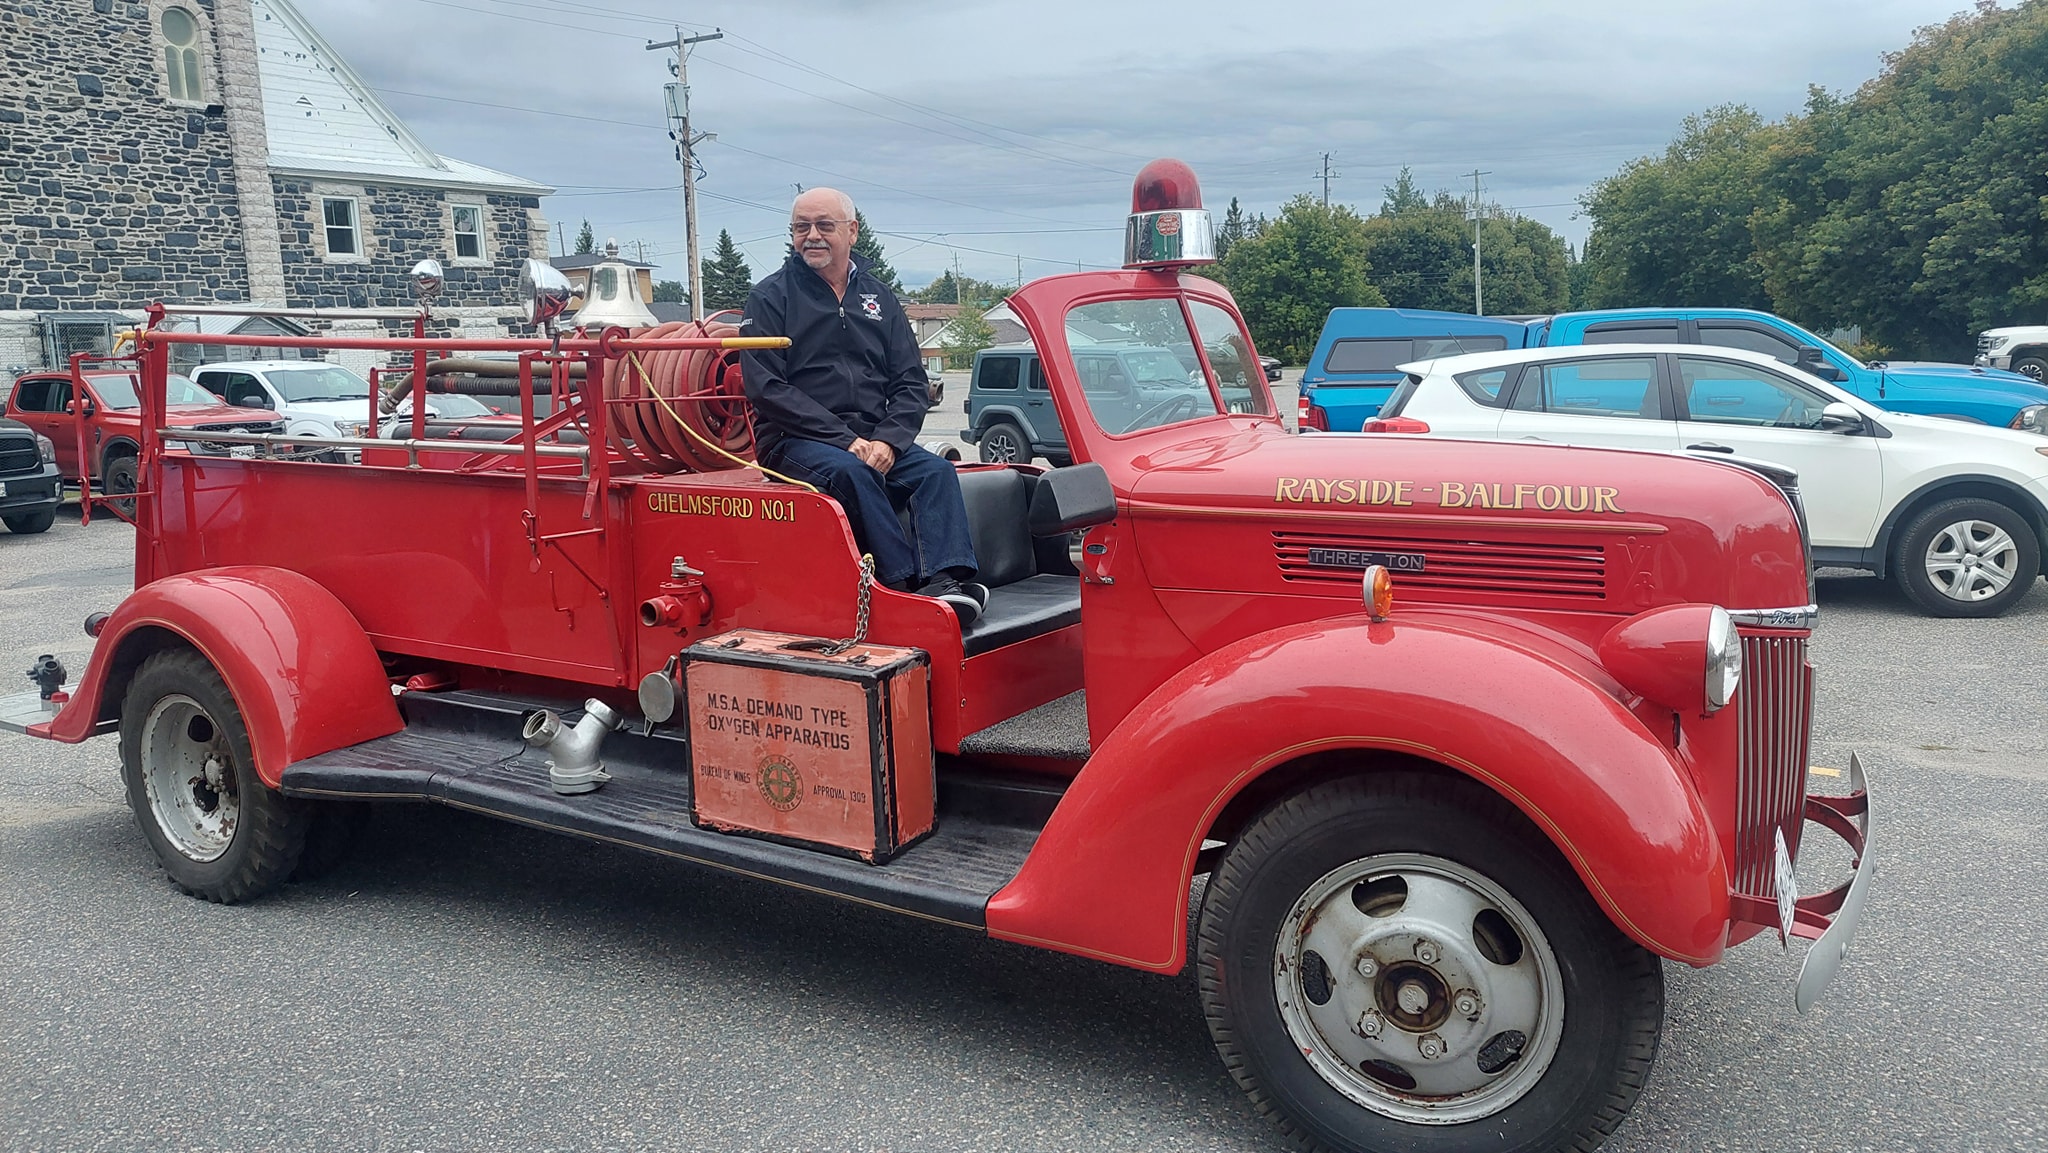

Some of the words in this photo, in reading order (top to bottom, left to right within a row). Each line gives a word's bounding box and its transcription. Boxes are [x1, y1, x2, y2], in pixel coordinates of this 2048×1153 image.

[1274, 476, 1415, 507] RAYSIDE
[1439, 481, 1625, 513] BALFOUR
[648, 492, 753, 518] CHELMSFORD
[761, 498, 795, 522] NO.1
[1311, 550, 1373, 566] THREE
[1385, 554, 1423, 569] TON
[1771, 610, 1799, 625] Ford
[708, 692, 742, 712] M.S.A.
[747, 698, 803, 721] DEMAND
[810, 707, 849, 728] TYPE
[708, 714, 760, 737] OXYGEN
[765, 723, 850, 751] APPARATUS
[724, 768, 731, 780] OF
[733, 770, 751, 784] MINES
[813, 784, 847, 801] APPROVAL
